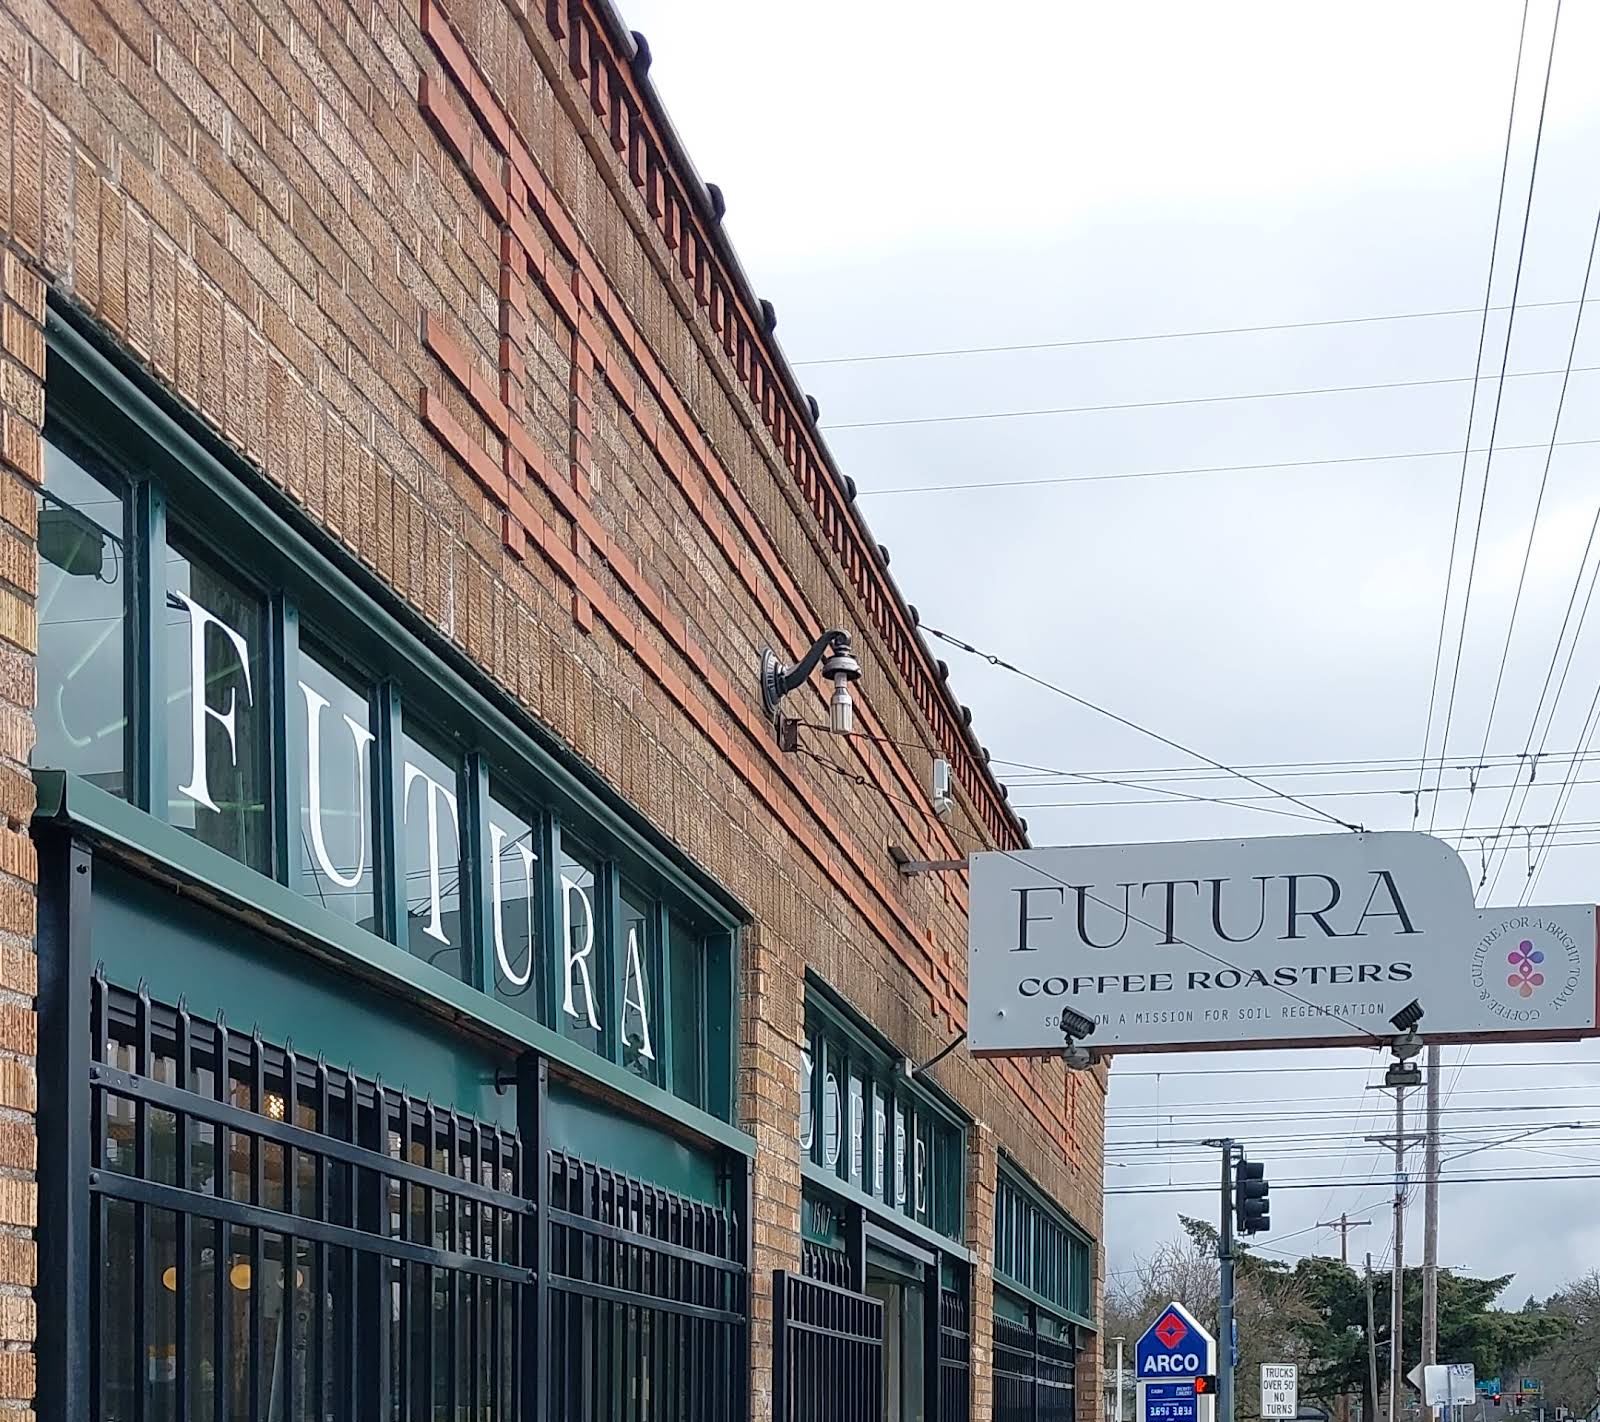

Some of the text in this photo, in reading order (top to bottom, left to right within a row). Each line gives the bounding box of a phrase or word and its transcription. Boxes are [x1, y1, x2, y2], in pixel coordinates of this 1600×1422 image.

[177, 588, 656, 1061] FUTURA
[1009, 869, 1424, 952] FUTURA
[1501, 917, 1529, 933] FOR
[1533, 918, 1542, 928] A
[1545, 922, 1580, 963] BRIGHT
[1472, 928, 1501, 988] CULTURE
[1018, 962, 1414, 997] COFFEE ROASTERS
[1119, 1014, 1126, 1025] A
[1135, 1011, 1193, 1023] MISSION
[1205, 1010, 1229, 1021] FOR
[1239, 1007, 1272, 1020] SOIL
[1282, 1003, 1384, 1018] REGENERATION
[1488, 1000, 1540, 1021] COFFEE
[1144, 1353, 1199, 1373] ARCO
[1265, 1368, 1294, 1378] TRUCKS
[1263, 1380, 1282, 1390] OVER
[1274, 1392, 1285, 1402] NO
[1267, 1404, 1293, 1414] TURNS
